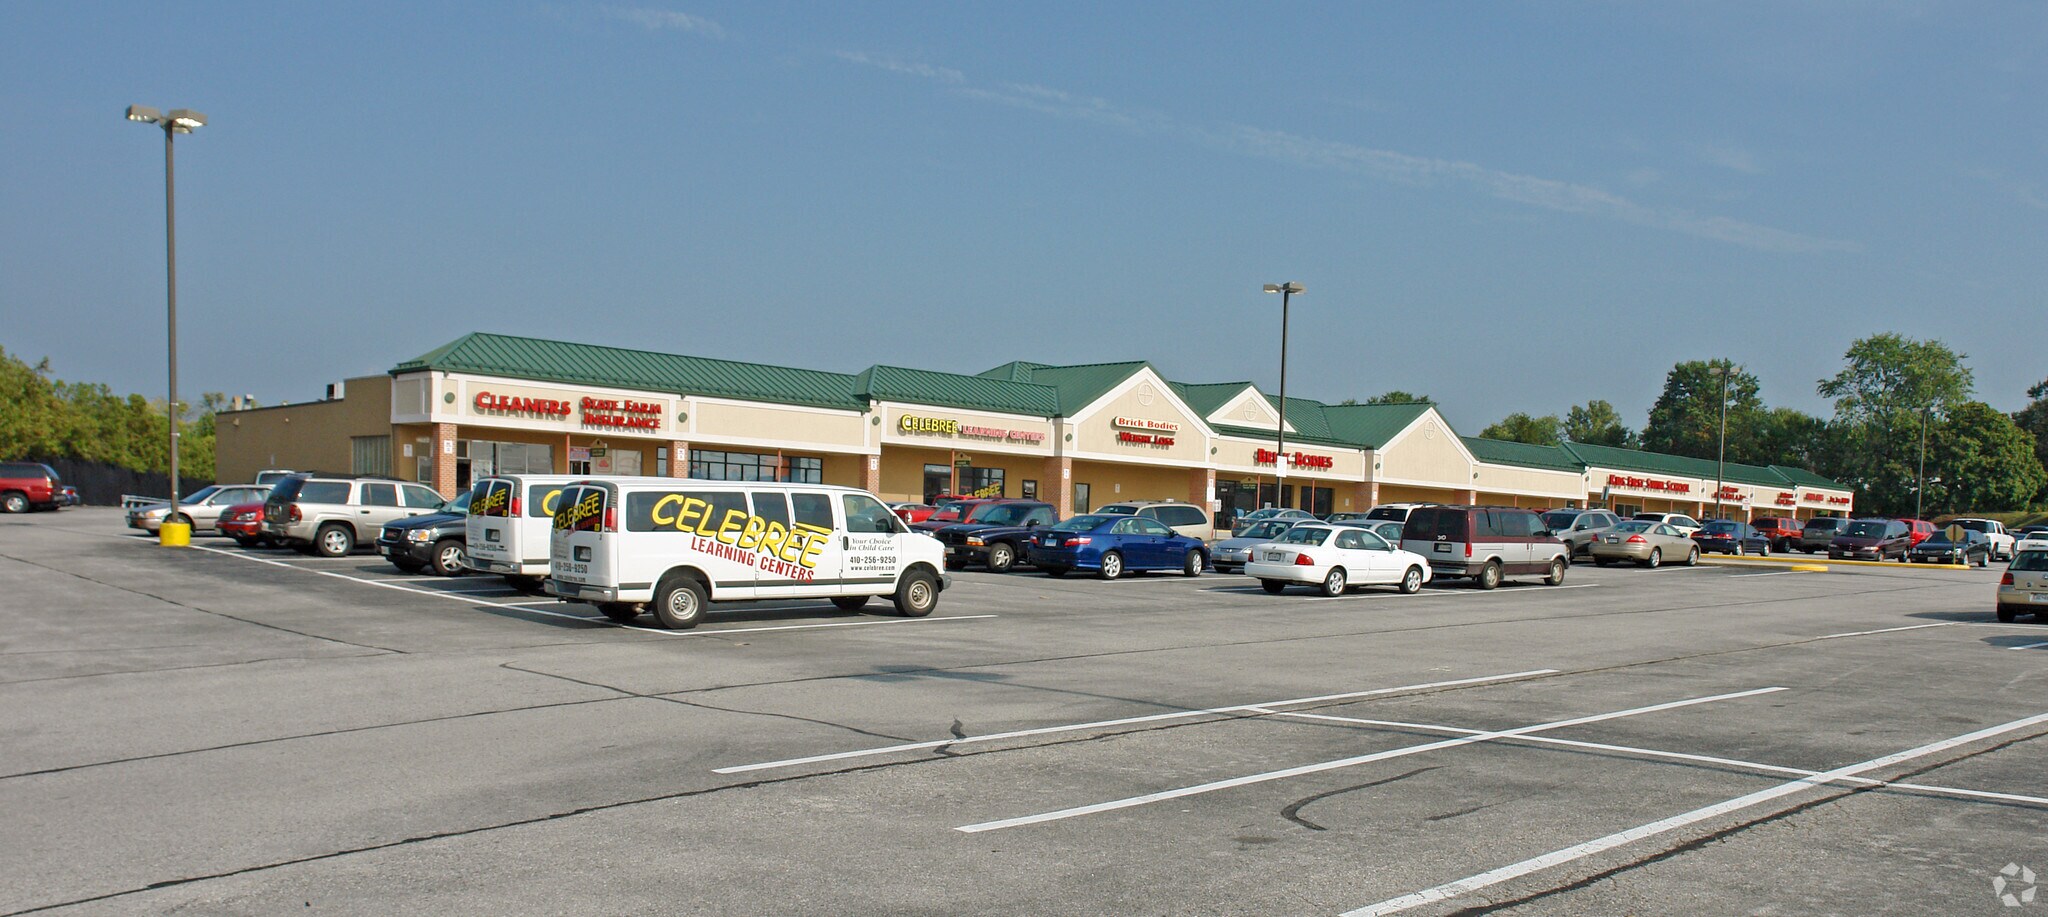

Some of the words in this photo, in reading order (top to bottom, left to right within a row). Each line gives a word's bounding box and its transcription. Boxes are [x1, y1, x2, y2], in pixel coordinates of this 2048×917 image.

[476, 391, 571, 415] CLEANERS
[581, 396, 619, 411] STATE
[624, 400, 662, 414] FARM
[584, 413, 661, 428] INSURANCE
[901, 414, 958, 434] CELEBREE
[962, 425, 1008, 439] LEARNING
[1009, 429, 1045, 441] CENTERS
[1118, 417, 1144, 427] Brick
[1147, 420, 1178, 431] Bodies
[1257, 448, 1291, 464] BRIK
[1295, 452, 1333, 468] BODIES
[554, 492, 600, 534] CELEBREE
[652, 493, 833, 569] CELEBREE
[691, 536, 755, 566] LEARNING
[760, 556, 814, 583] CENTERS
[849, 556, 897, 564] 410-256-9250
